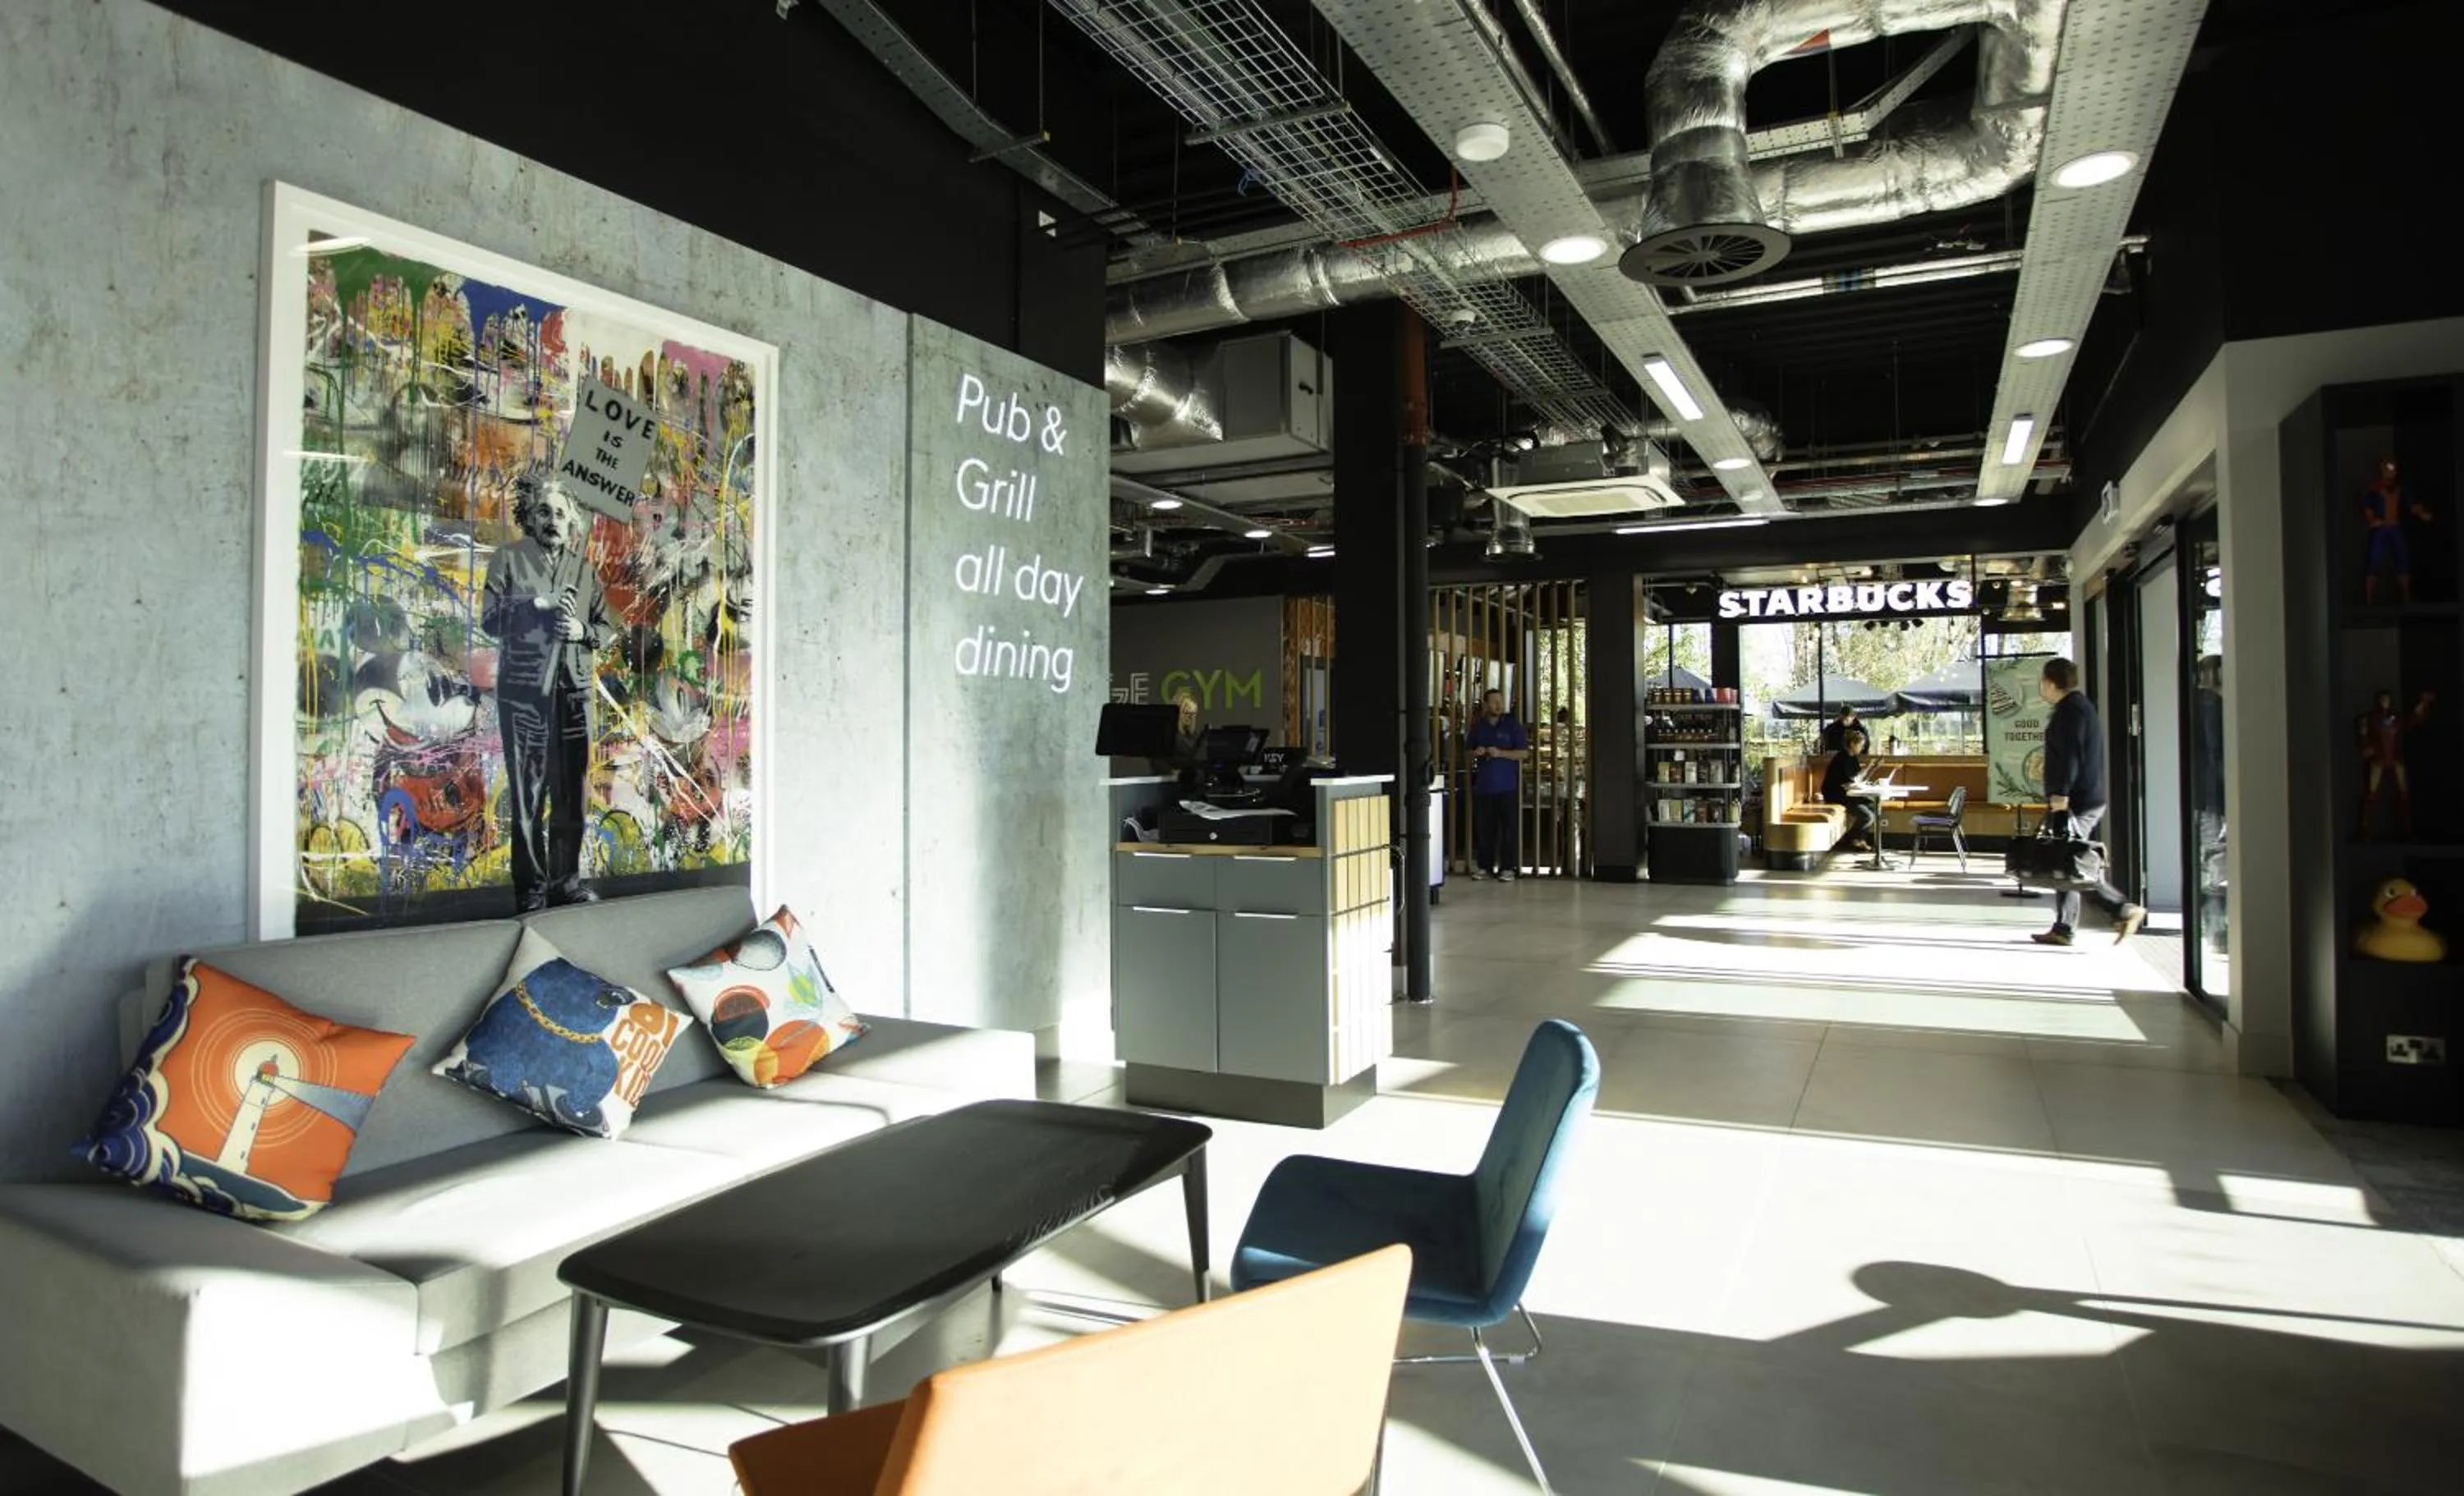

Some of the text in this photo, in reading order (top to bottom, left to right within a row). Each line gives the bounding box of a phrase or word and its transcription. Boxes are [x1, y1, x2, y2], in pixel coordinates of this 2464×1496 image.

[585, 389, 655, 439] LOVE
[957, 374, 1068, 455] Pub &
[595, 447, 620, 470] THE
[604, 430, 623, 448] IS
[561, 459, 636, 507] ANSWER
[957, 457, 1037, 522] Grill
[955, 544, 1084, 618] all day
[1718, 581, 1973, 618] STARBUCKS
[955, 625, 1073, 693] dining
[2014, 718, 2040, 728] GOOD
